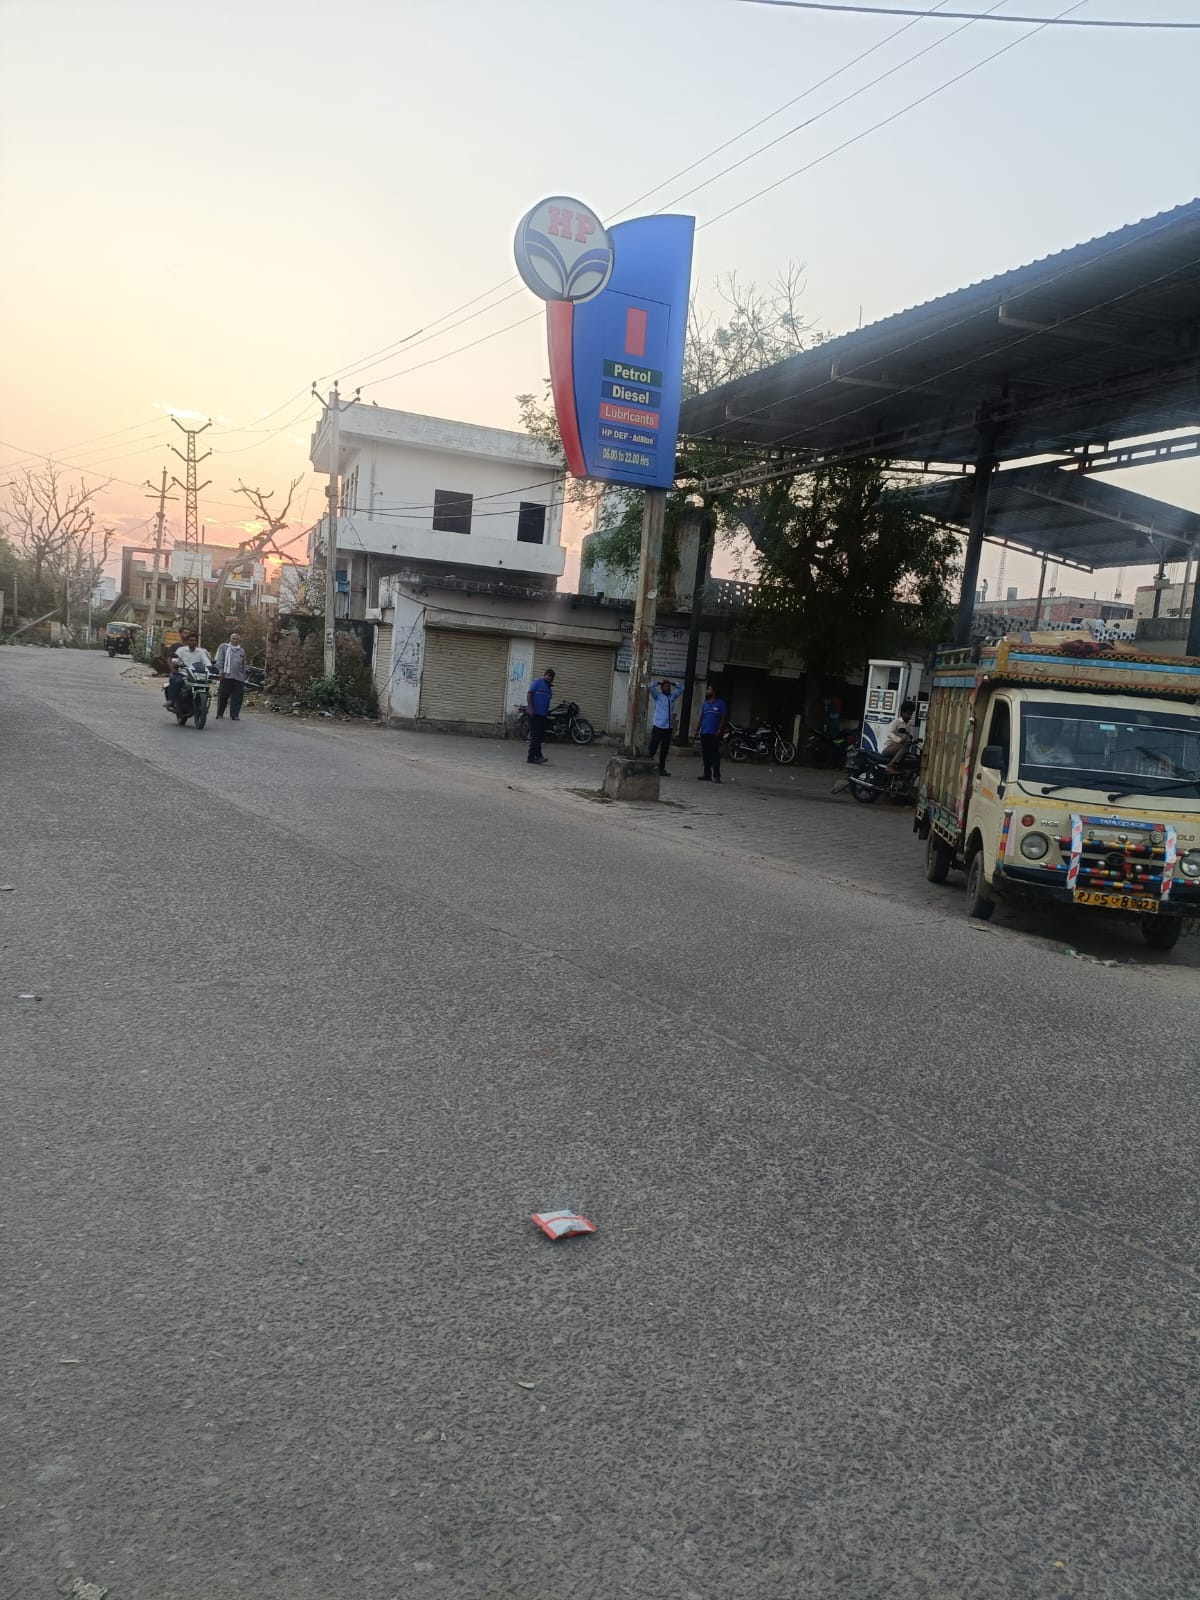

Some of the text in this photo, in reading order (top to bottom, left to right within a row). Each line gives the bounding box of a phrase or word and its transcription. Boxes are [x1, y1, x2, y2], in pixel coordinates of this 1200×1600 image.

[547, 205, 596, 244] HP
[613, 363, 652, 384] Petrol
[612, 384, 650, 404] Diesel
[605, 405, 655, 426] Lubricants
[601, 427, 613, 437] HP
[613, 430, 629, 440] DEF
[618, 450, 625, 462] to
[1077, 891, 1090, 903] RJ
